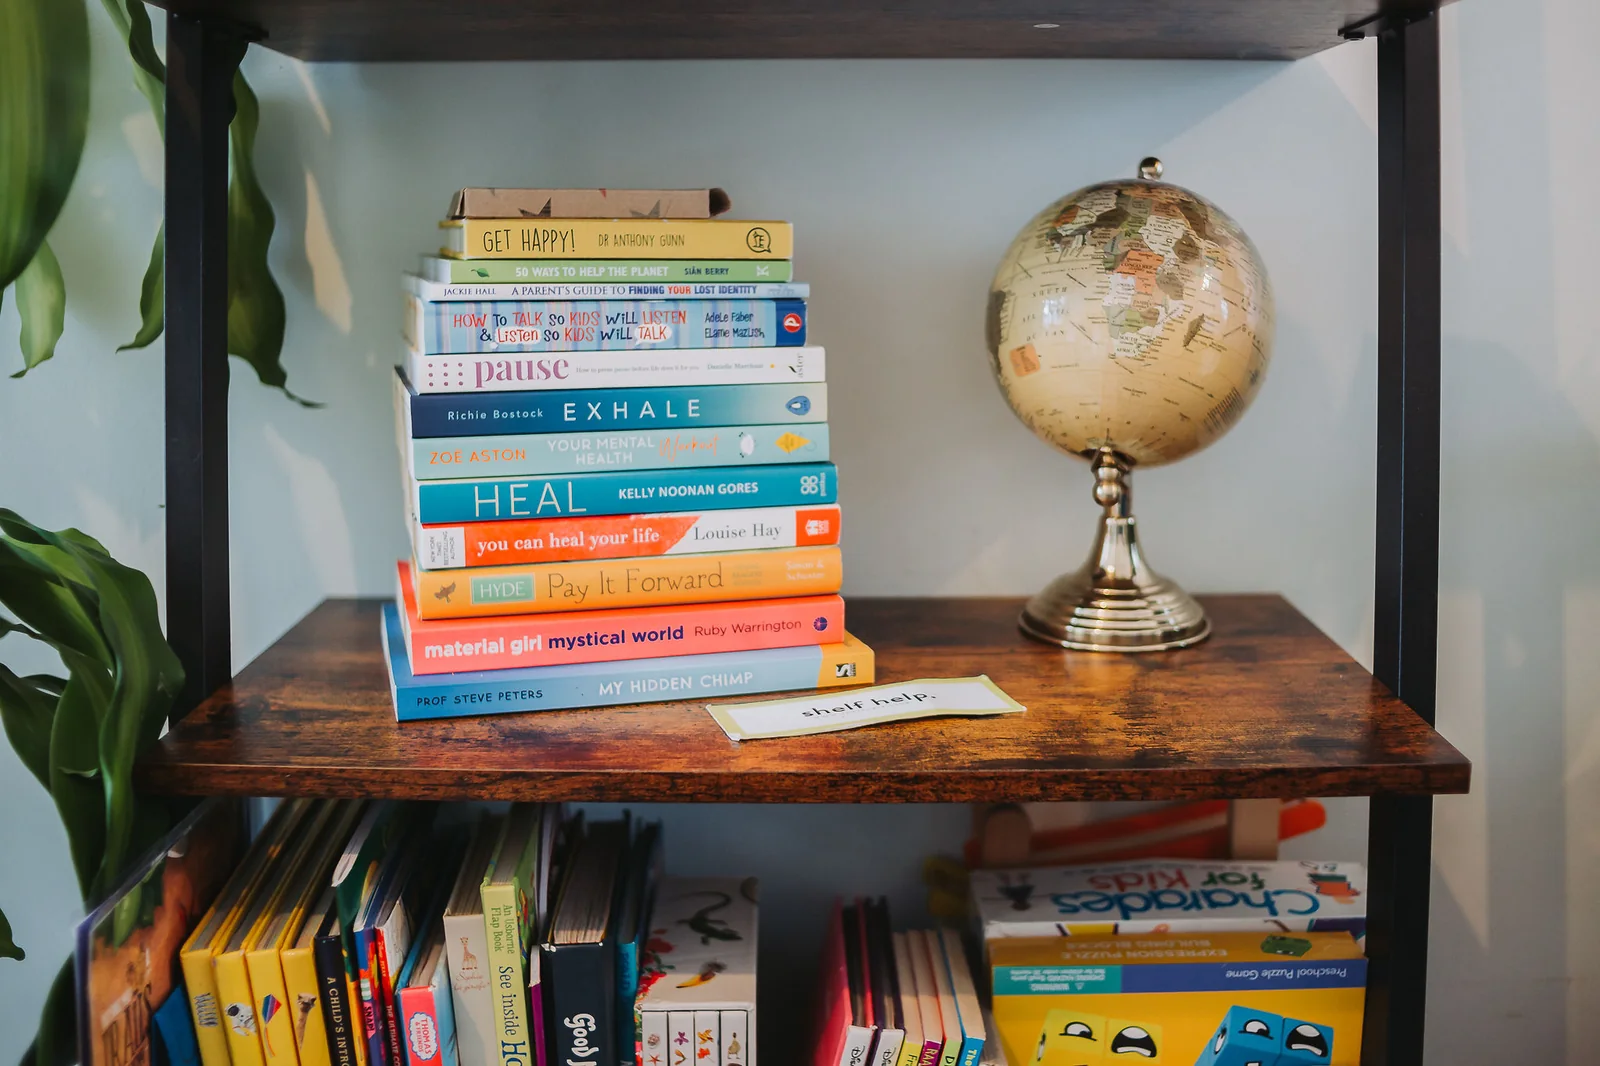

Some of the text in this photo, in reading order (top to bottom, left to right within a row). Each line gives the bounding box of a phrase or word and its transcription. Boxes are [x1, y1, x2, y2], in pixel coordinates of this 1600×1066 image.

[483, 228, 576, 253] GET HAPPY!
[598, 234, 685, 247] DR ANTHONY GUNN
[515, 266, 669, 277] 50 WAYS TO HELP THE PLANET
[705, 267, 730, 276] BERRY
[443, 288, 472, 296] JACKIE
[511, 285, 757, 296] A PARENT'S GUIDE TO FINDING YOUR LOST IDENTITY
[453, 313, 487, 328] HOW
[512, 311, 543, 326] TALK
[569, 311, 600, 326] KIDS
[642, 310, 687, 325] LISTEN
[480, 328, 493, 342] &
[564, 327, 595, 342] KIDS
[638, 326, 667, 340] TALK
[475, 358, 570, 388] pause
[448, 408, 544, 421] Richie Bostock
[563, 399, 701, 422] EXHALE
[548, 436, 656, 452] YOUR MENTAL
[469, 448, 526, 464] ASTON
[576, 452, 633, 465] HEALTH
[474, 481, 587, 517] HEAL
[619, 481, 759, 500] KELLY NOONAN GORES
[477, 527, 660, 556] you can heal your life
[694, 523, 782, 541] Louise Hay
[480, 581, 526, 598] HYDE
[548, 573, 589, 604] Pay
[600, 570, 616, 595] It
[625, 561, 725, 594] Forward
[694, 619, 802, 637] Ruby Warrington
[425, 625, 684, 659] material girl mystical world
[599, 672, 753, 696] MY HIDDEN CHIMP
[416, 690, 543, 706] PROF STEVE PETERS
[801, 692, 937, 718] shelf help.
[1088, 868, 1190, 893] Kids
[1201, 871, 1266, 891] for
[1051, 888, 1321, 920] Charades
[490, 907, 504, 952] Flap Book
[503, 904, 516, 955] An Usborne
[1061, 949, 1228, 961] EXPRESSION PUZZLE
[498, 965, 514, 989] See
[1225, 966, 1347, 980] Preschool Puzzle Game
[329, 988, 345, 1033] CHILD'S
[364, 1006, 375, 1031] SNAP!
[386, 1005, 394, 1018] THE
[501, 993, 519, 1037] inside
[388, 1020, 399, 1054] ULTIMATE
[415, 1027, 424, 1053] FRIENDS
[421, 1018, 433, 1054] THOMAS
